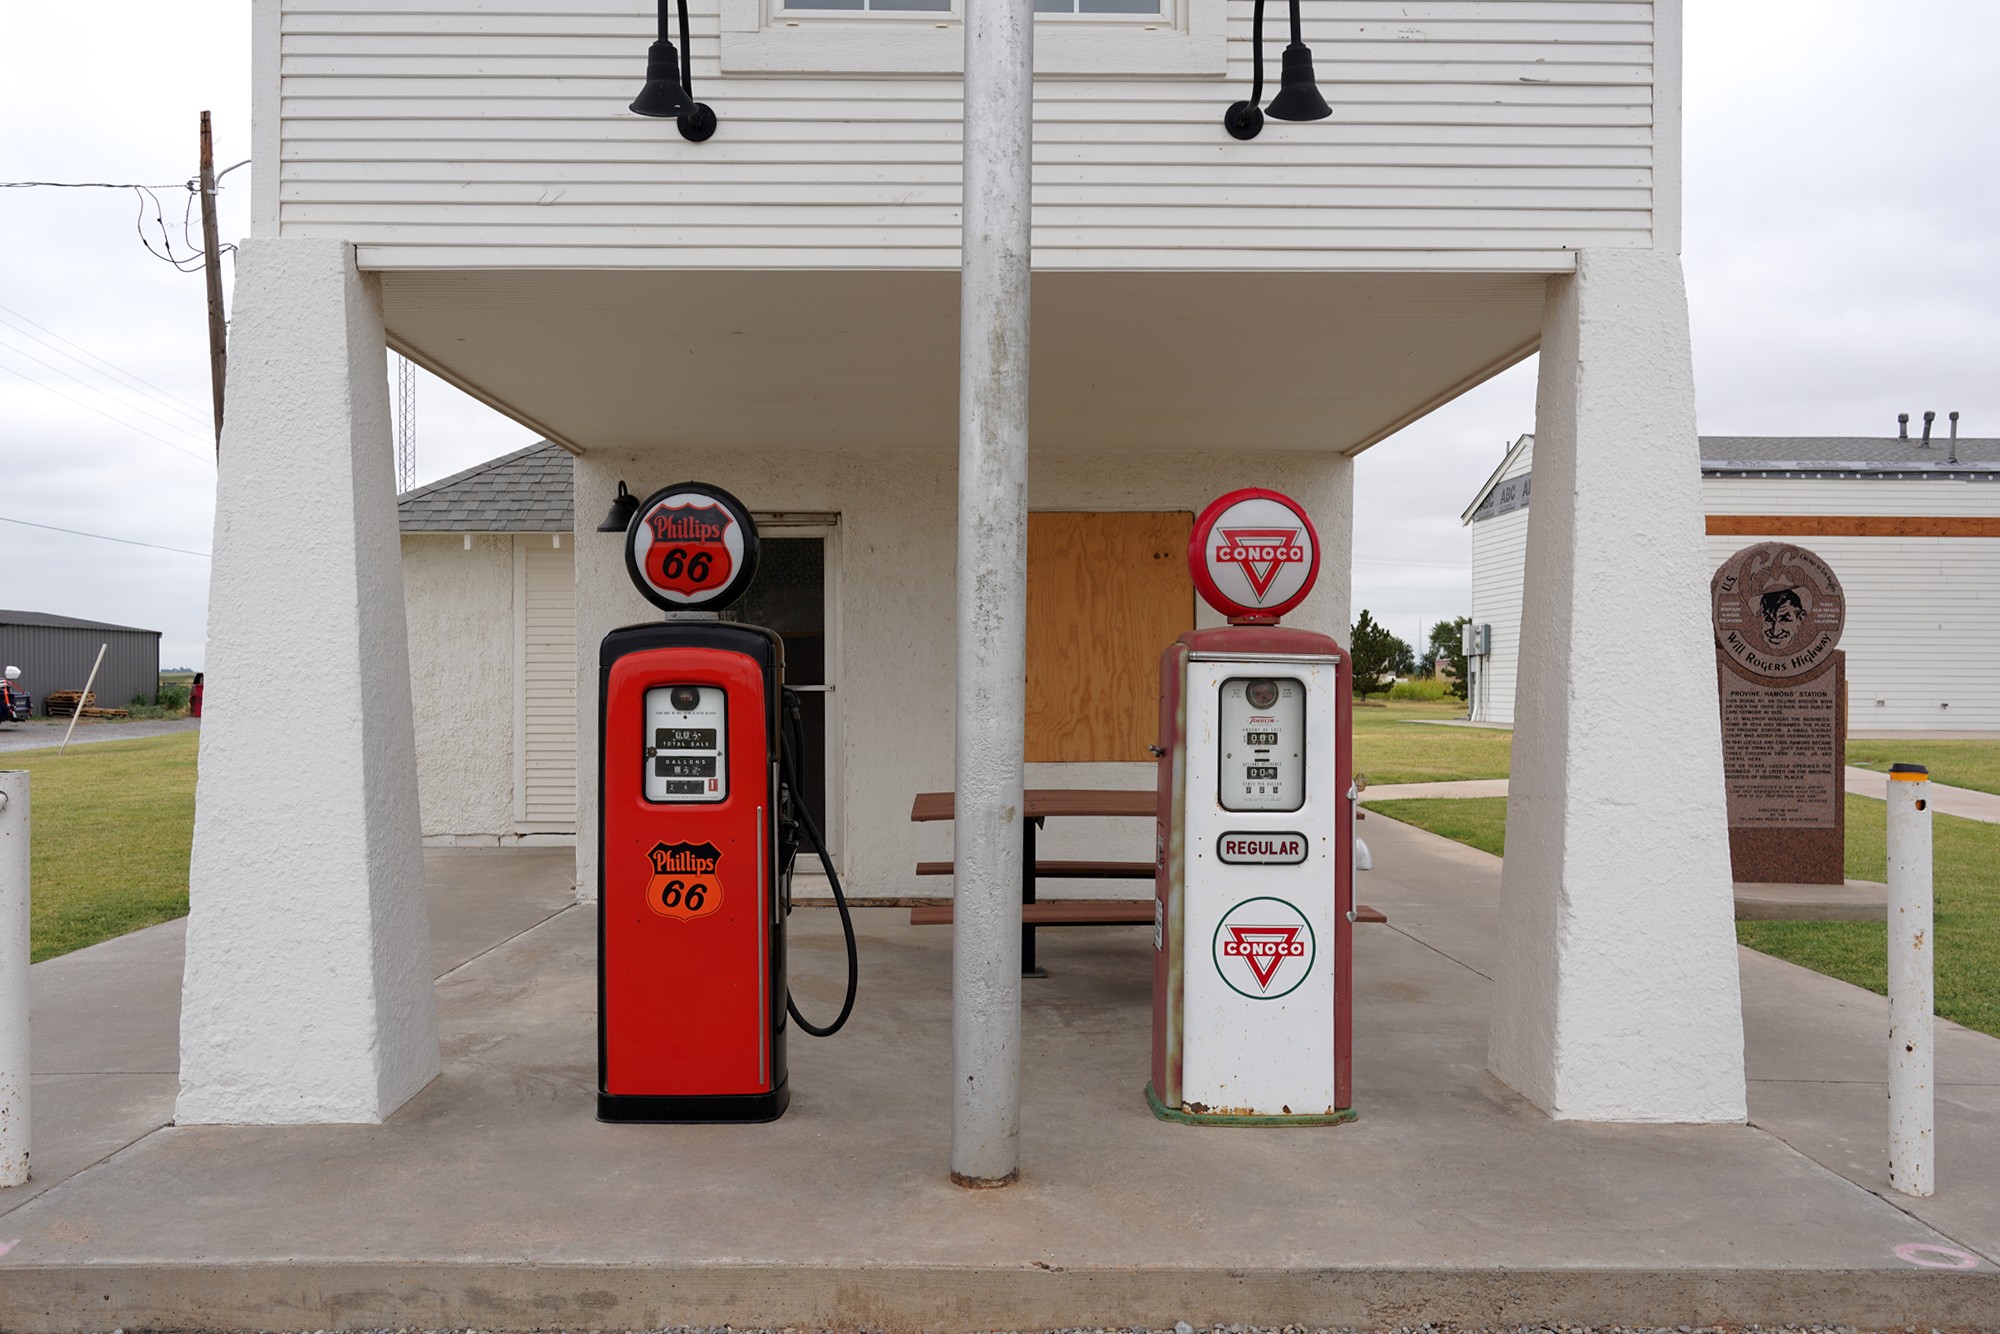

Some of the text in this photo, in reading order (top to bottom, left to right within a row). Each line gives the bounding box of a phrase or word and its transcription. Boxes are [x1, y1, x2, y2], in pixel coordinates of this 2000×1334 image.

[1500, 485, 1516, 504] ABC
[654, 515, 721, 545] Phillips
[662, 548, 713, 583] 66
[1219, 547, 1301, 561] CONOCO
[1727, 632, 1746, 656] Will
[1226, 841, 1299, 855] REGULAR
[653, 850, 714, 877] Phillips
[662, 880, 708, 911] 66
[1227, 942, 1302, 955] CONOCO
